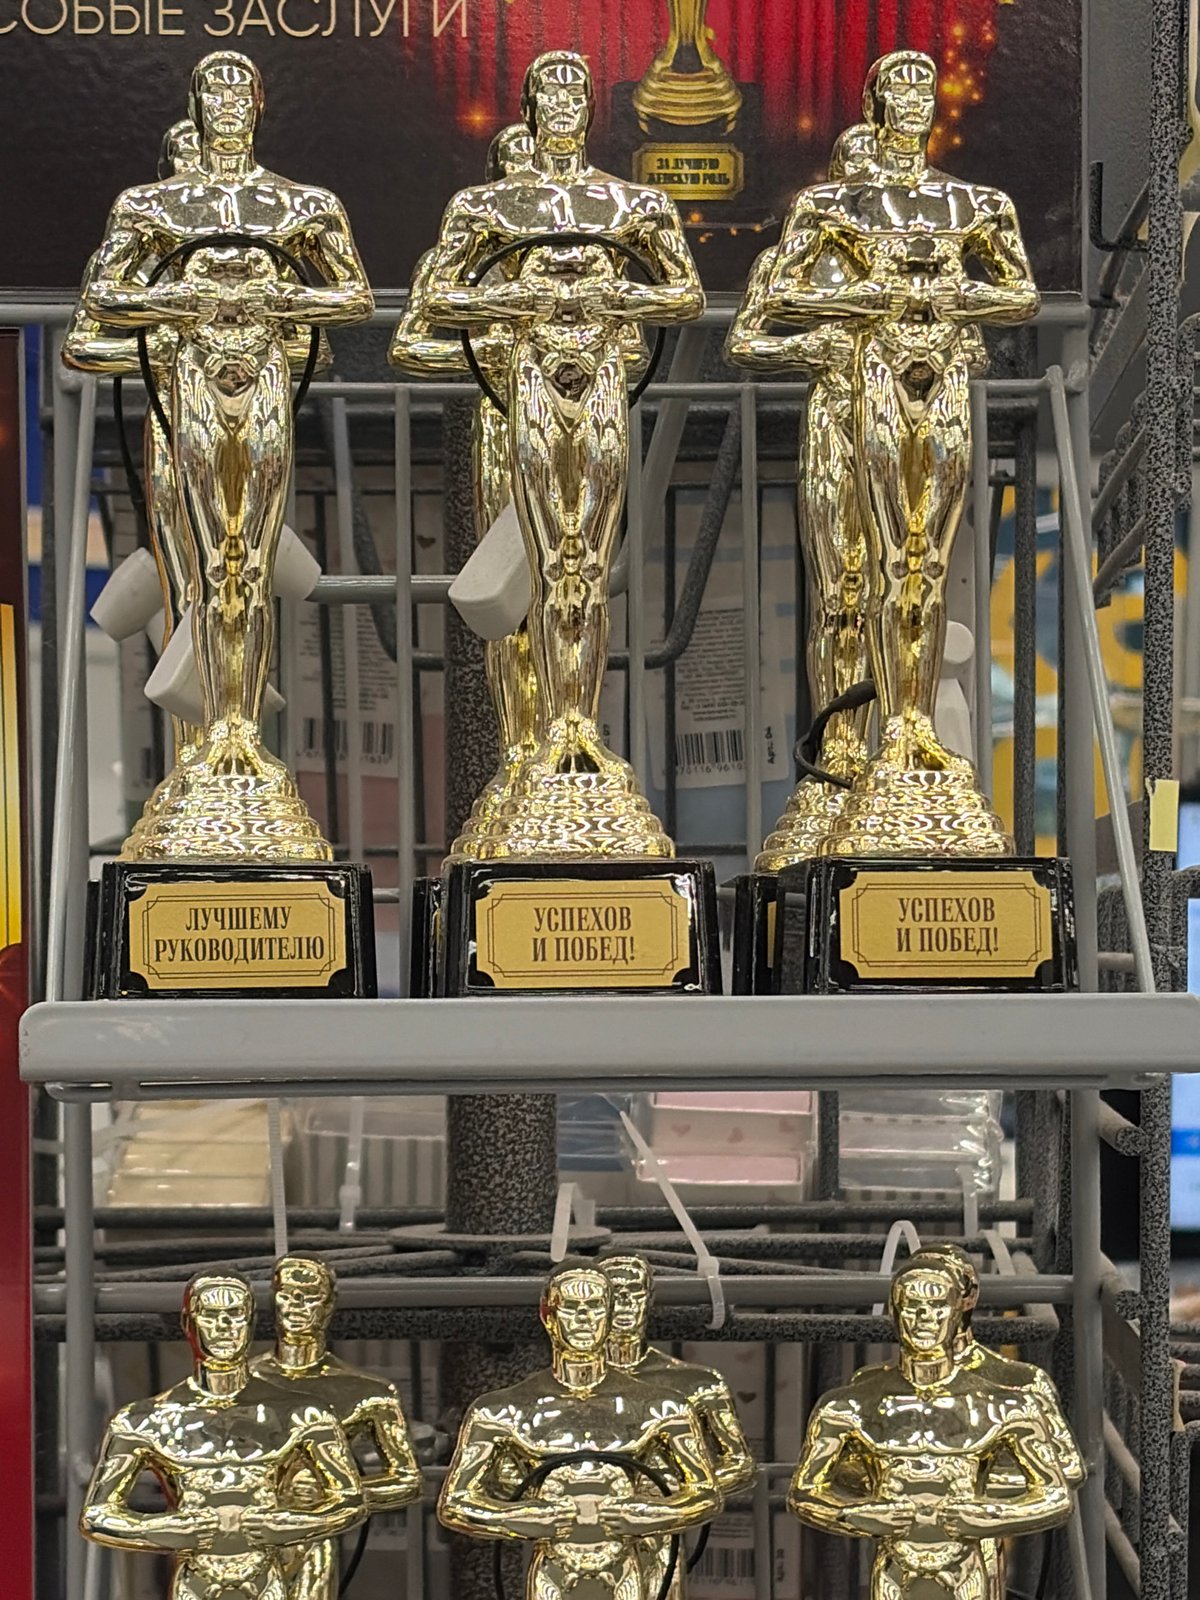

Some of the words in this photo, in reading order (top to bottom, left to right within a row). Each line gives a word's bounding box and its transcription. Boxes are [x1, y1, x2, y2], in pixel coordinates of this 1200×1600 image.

[185, 906, 292, 931] ЛУЧШЕМУ
[533, 906, 632, 933] УСПЕХОВ
[898, 897, 996, 923] УСПЕХОВ
[155, 935, 325, 965] РУКОВОДИТЕЛЮ
[532, 937, 547, 962] И
[554, 936, 636, 965] ПОБЕД!
[897, 927, 911, 952] И
[919, 926, 999, 957] ПОБЕД!
